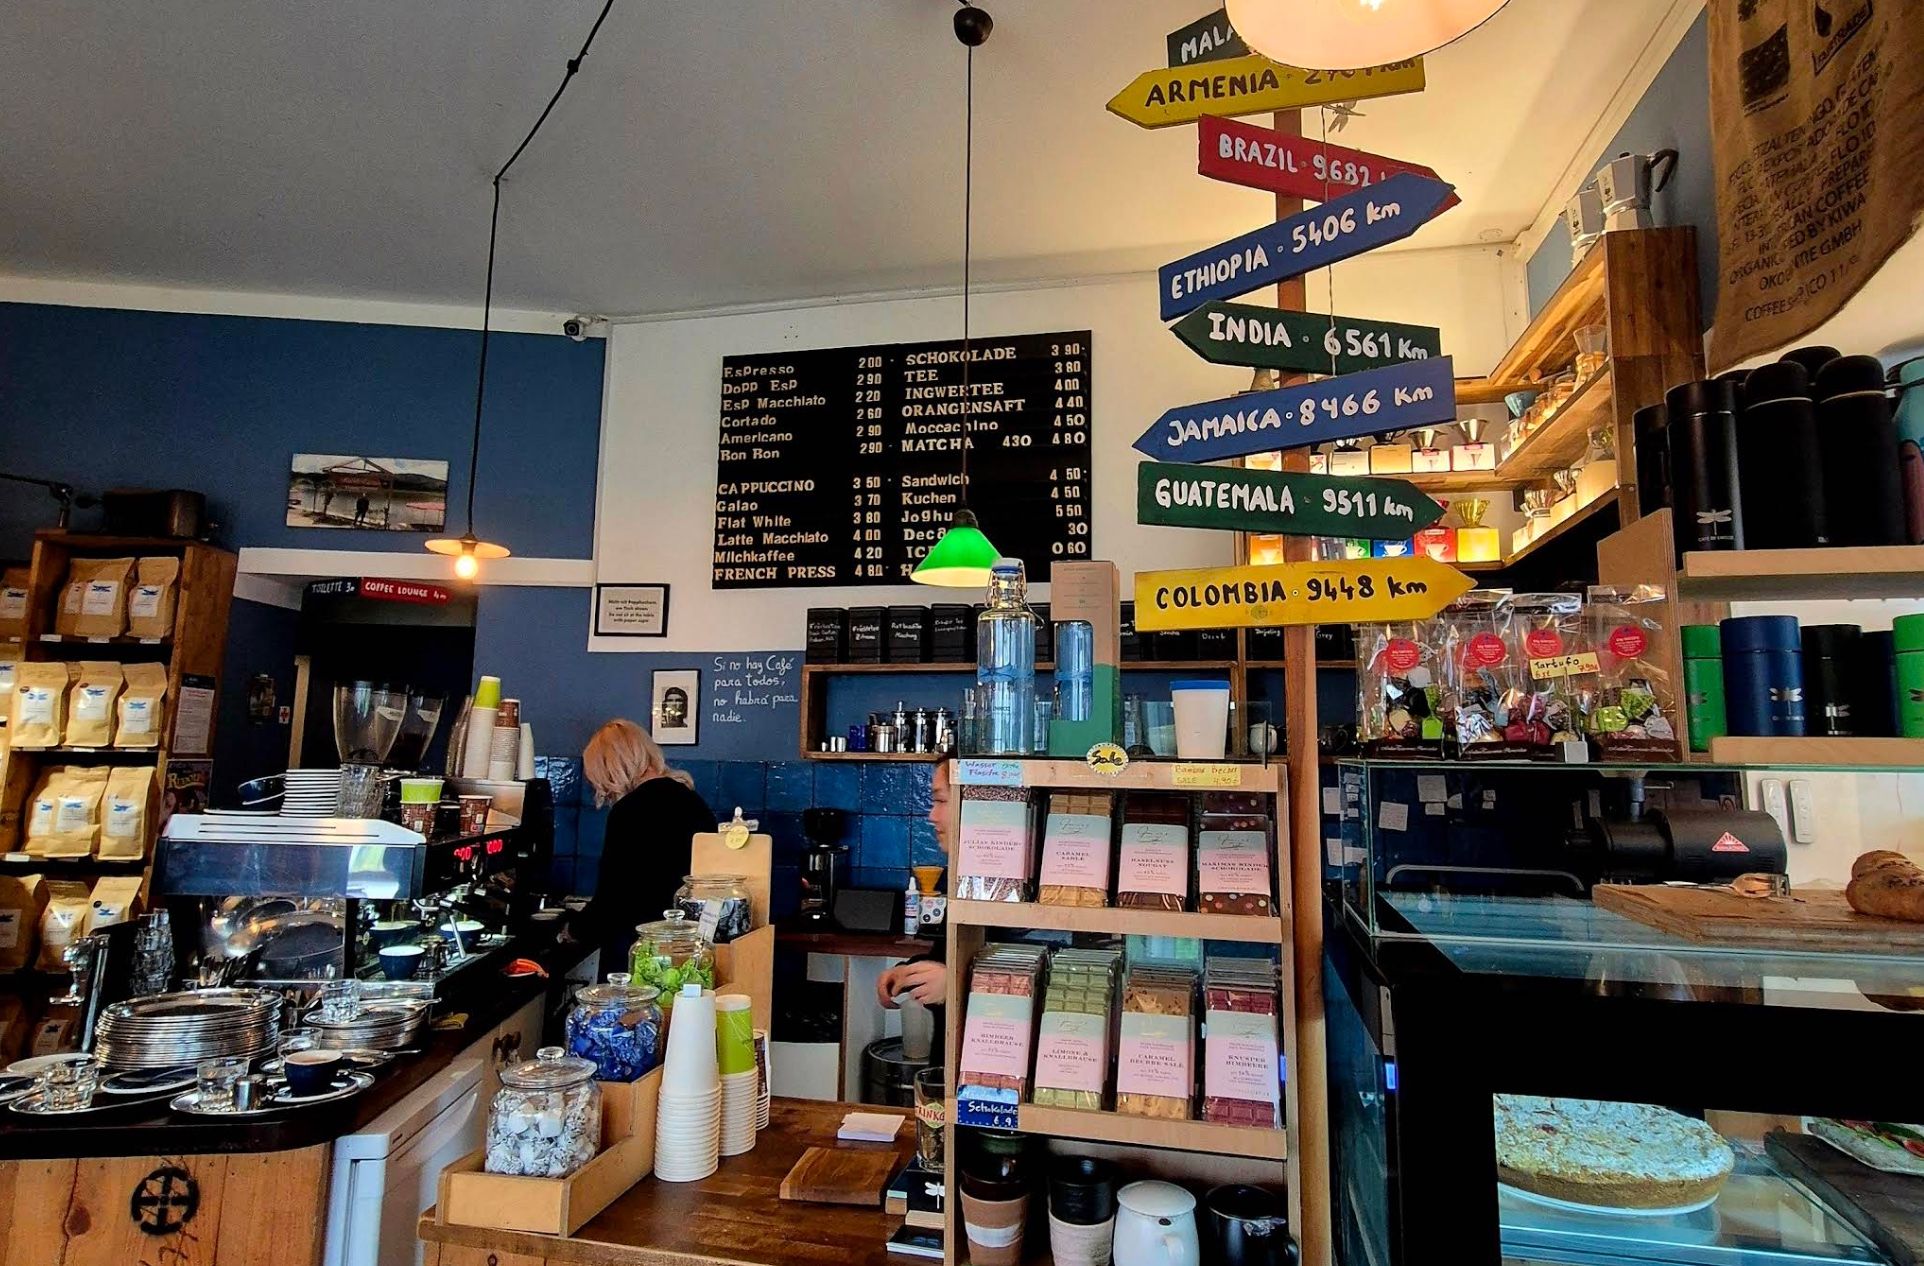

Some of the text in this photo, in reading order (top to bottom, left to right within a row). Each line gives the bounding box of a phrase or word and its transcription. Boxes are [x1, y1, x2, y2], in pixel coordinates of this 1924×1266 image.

[1145, 69, 1280, 108] ARMENIA
[1219, 134, 1372, 188] BRAZIL 9682
[1171, 200, 1401, 299] ETHIOPIA 5406 km
[1207, 312, 1292, 348] INDIA
[1323, 327, 1392, 359] 6561
[906, 347, 1016, 365] SCHOKOLADE
[722, 364, 794, 377] Espresso
[904, 370, 938, 382] TEE
[722, 380, 797, 394] Dopp Esp
[906, 382, 1003, 399] INGWERTEE
[723, 395, 825, 410] Esp Macchiato
[902, 398, 1025, 416] ORANGENSAFT
[721, 413, 776, 427] Cortado
[1167, 408, 1282, 447] JAMAICA
[1299, 390, 1380, 426] 8466
[720, 431, 792, 444] Americano
[902, 437, 974, 452] MATCHA
[1003, 435, 1031, 447] 430
[721, 449, 779, 460] Bon Bon
[717, 479, 814, 494] CAPPUCCINO
[902, 473, 969, 487] Sandwich
[902, 492, 956, 504] Kuchen
[1154, 478, 1295, 515] GUATEMALA
[1323, 488, 1378, 517] 9511
[715, 500, 757, 513] Galao
[718, 516, 791, 528] Flat White
[901, 510, 953, 522] Joghu
[718, 532, 828, 545] Latte Macchiato
[713, 550, 794, 563] Milchkaffee
[713, 566, 835, 580] FRENCH PRESS
[365, 581, 394, 593] COFFEE
[398, 583, 428, 597] LOUNGE
[1155, 580, 1287, 610] COLOMBIA
[1306, 574, 1375, 601] 9448
[714, 654, 795, 676] Si no hay Café
[1534, 656, 1580, 669] Tartufo
[714, 673, 786, 692] para todos,
[713, 690, 799, 709] no habrá para
[712, 709, 747, 723] nadie.
[1092, 749, 1124, 766] Sale
[971, 1038, 1024, 1047] KNALLBRAUSE
[1043, 1054, 1097, 1062] KNALLBRAUSE
[1138, 1054, 1176, 1062] CARAMEL
[1225, 1061, 1269, 1069] HIMBEERE
[1228, 1054, 1266, 1063] KNUSPER
